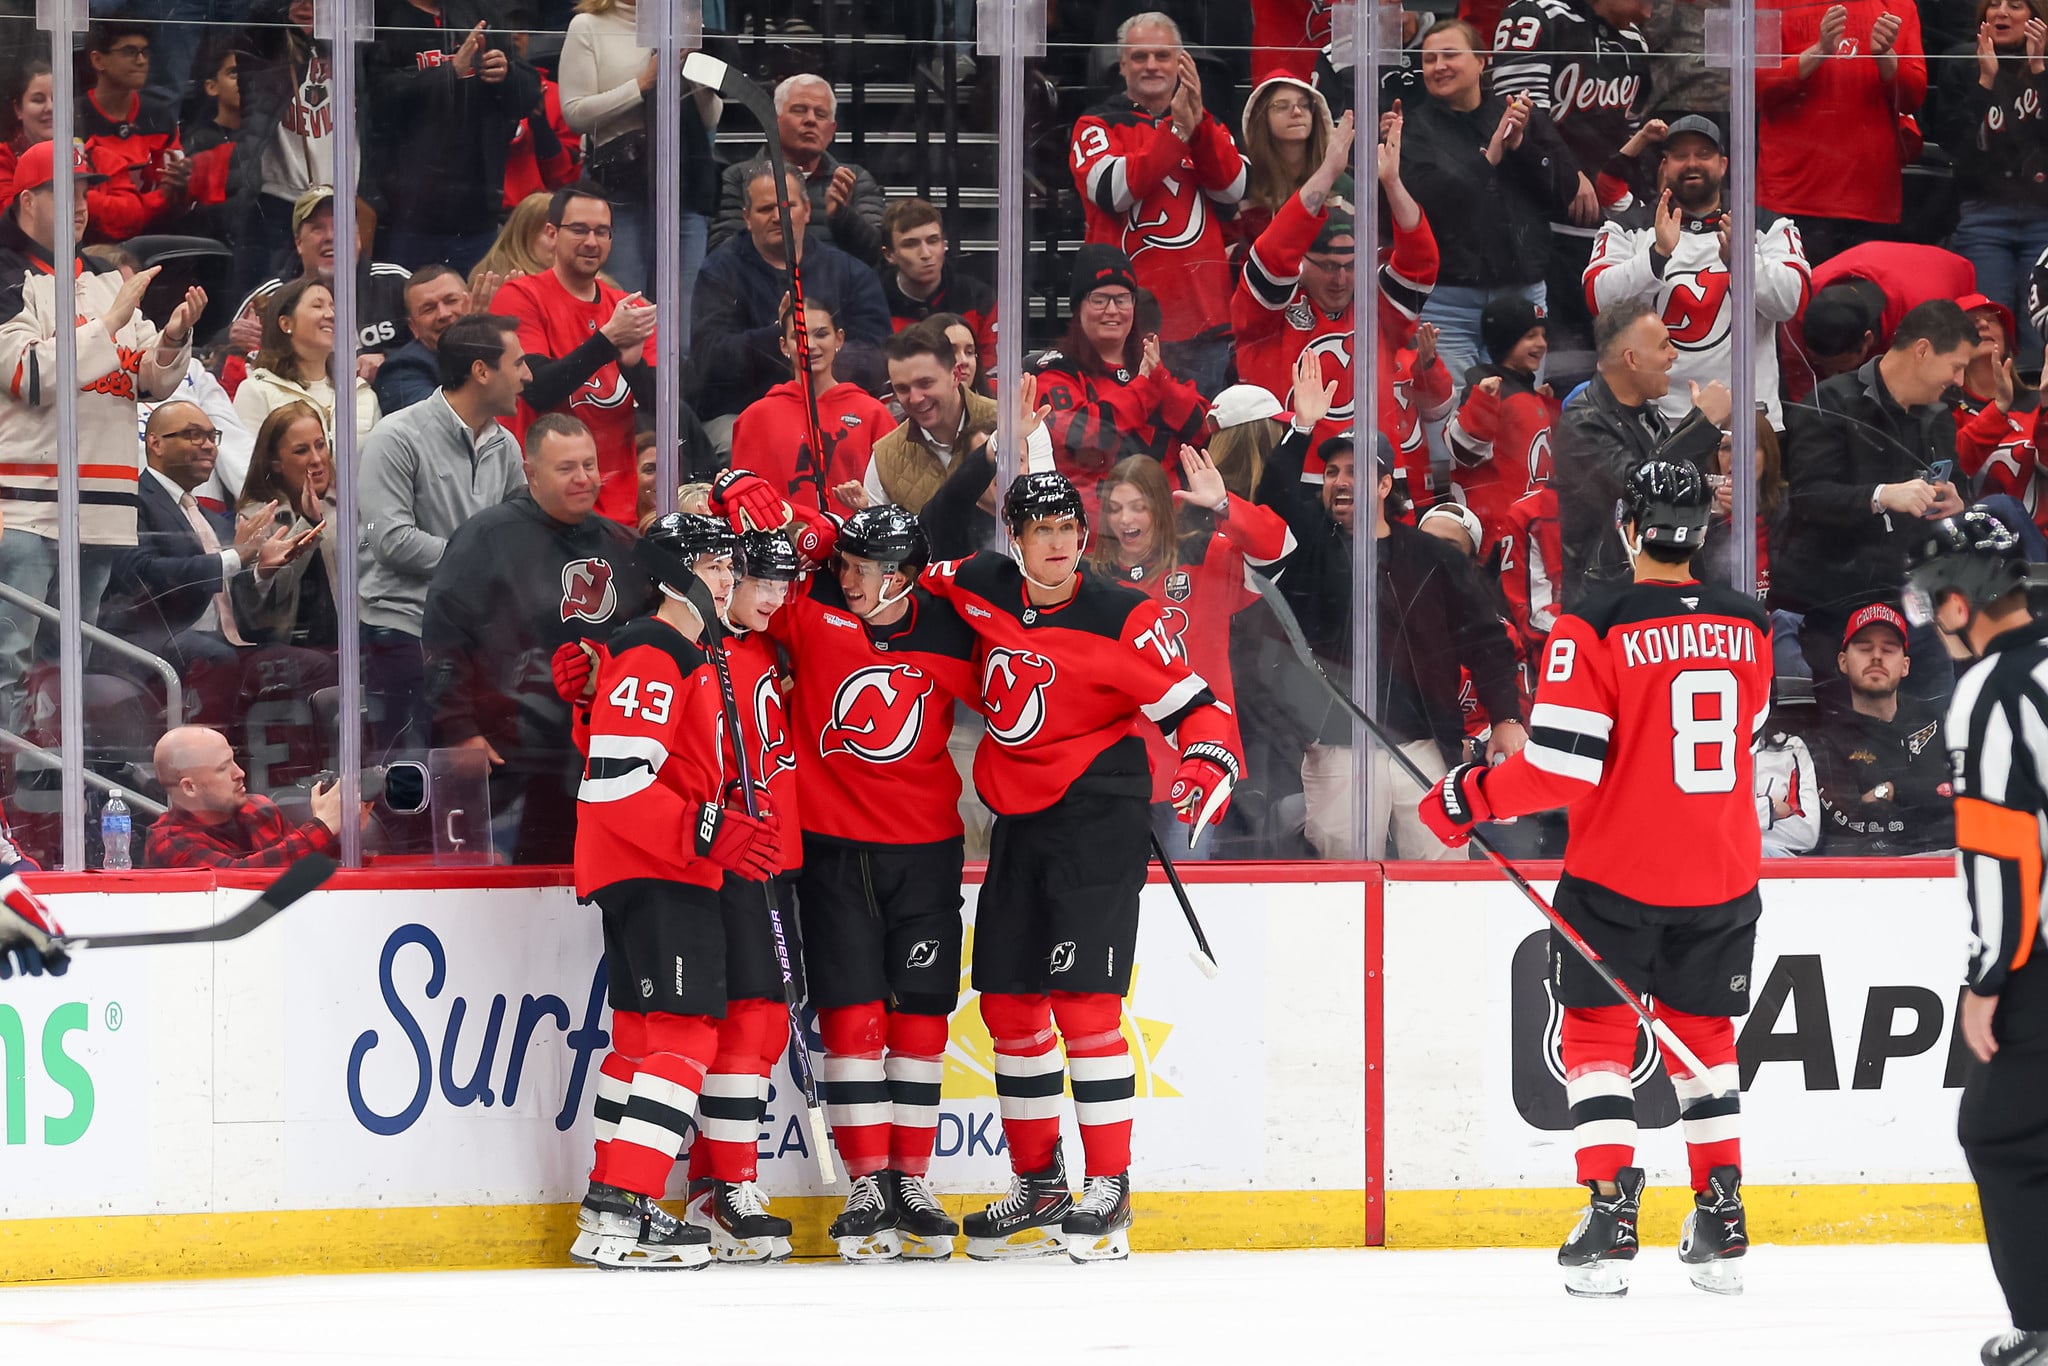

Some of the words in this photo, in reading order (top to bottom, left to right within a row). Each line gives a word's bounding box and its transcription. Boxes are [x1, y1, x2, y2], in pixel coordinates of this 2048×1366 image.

[1495, 16, 1541, 51] 63
[1549, 62, 1641, 122] Jersey
[1073, 125, 1110, 168] 13
[1673, 526, 1689, 543] 8
[1134, 617, 1182, 666] 72
[1546, 638, 1576, 682] 8
[1622, 622, 1757, 669] KOVACEVI
[609, 676, 674, 725] 43
[1671, 669, 1739, 795] 8
[771, 909, 791, 971] BAUER
[675, 955, 683, 996] BAUER
[757, 1114, 809, 1159] EA
